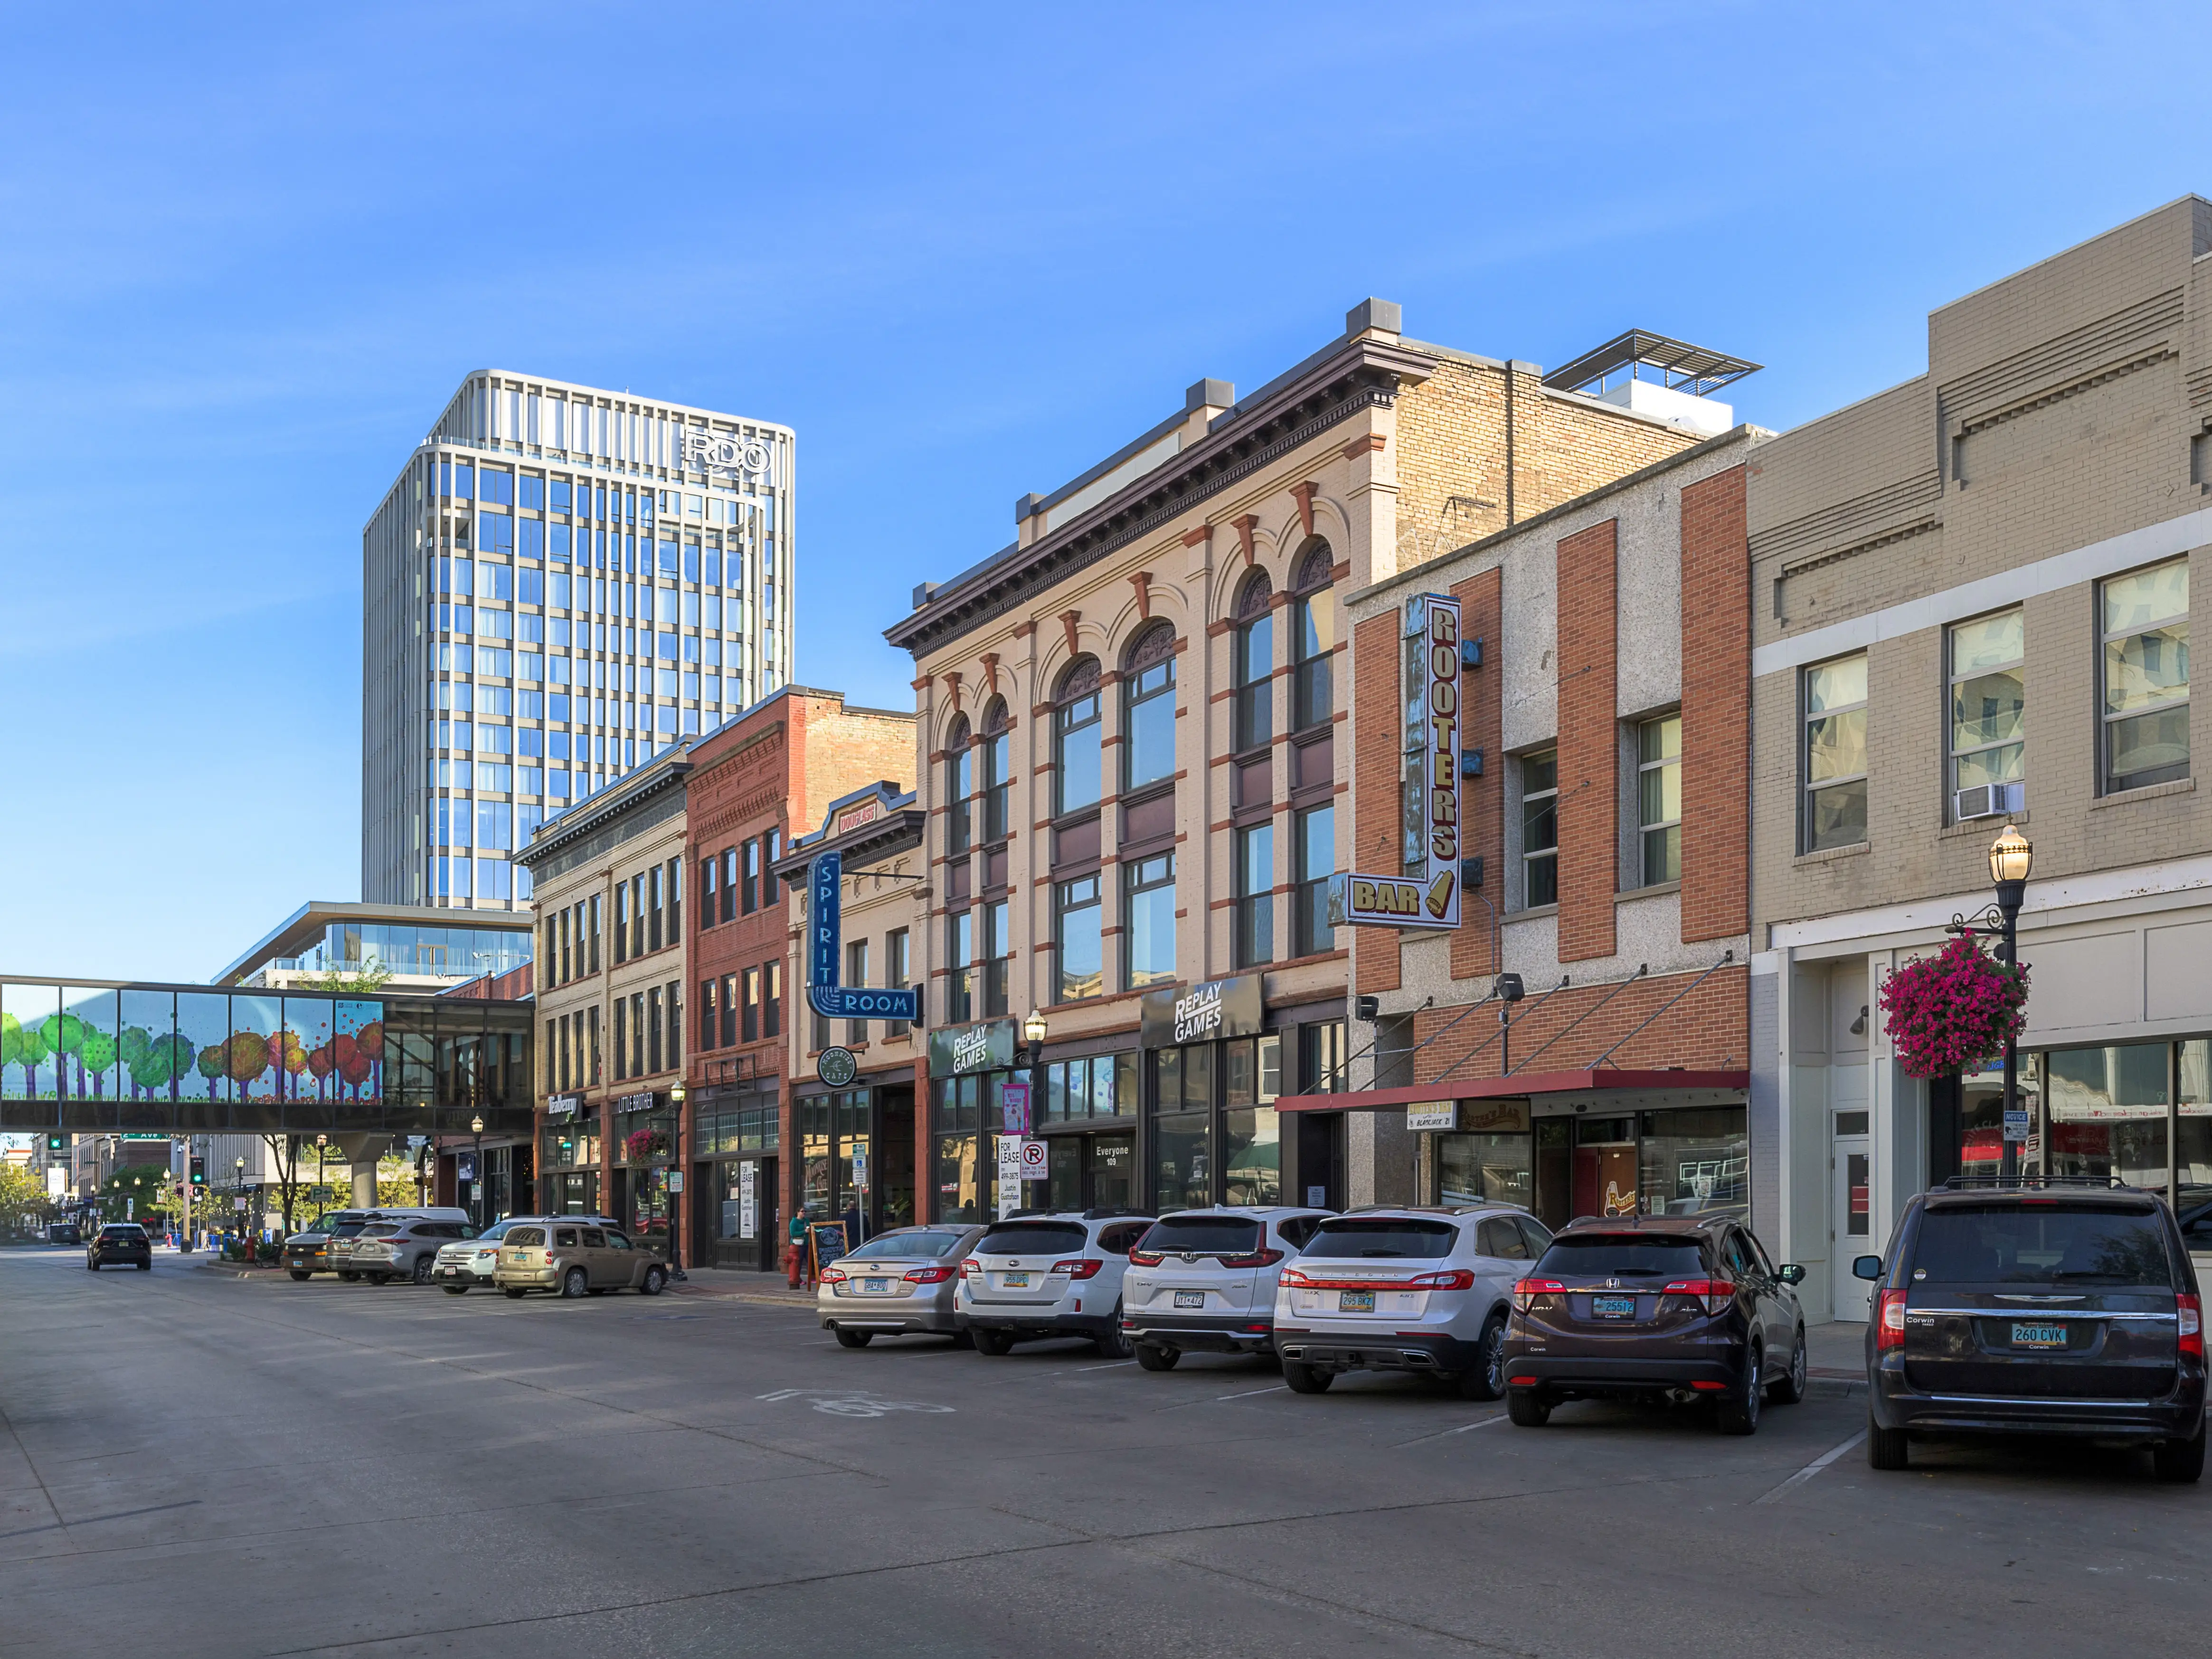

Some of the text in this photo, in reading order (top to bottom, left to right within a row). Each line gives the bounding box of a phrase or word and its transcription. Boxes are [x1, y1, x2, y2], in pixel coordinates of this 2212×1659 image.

[686, 430, 771, 473] RDO
[1432, 607, 1457, 862] ROOTERS
[841, 805, 874, 831] DOUGLASS
[1353, 881, 1420, 916] BAR
[820, 866, 832, 984] SPIRIT
[845, 995, 907, 1013] ROOM
[1175, 981, 1222, 1024] REPLAY
[1175, 1006, 1221, 1042] GAMES
[954, 1024, 987, 1058] REPLAY
[822, 1051, 852, 1065] MOONRISE
[954, 1045, 987, 1074] GAMES
[548, 1094, 577, 1115] Teaberry
[619, 1092, 653, 1113] LITTLE BROTHER
[2005, 1112, 2026, 1121] NOTICE
[1001, 1142, 1011, 1151] FOR
[1097, 1146, 1128, 1157] Everyone
[1001, 1152, 1019, 1163] LEASE
[1107, 1158, 1116, 1166] 109
[741, 1174, 753, 1182] LEASE
[313, 1188, 322, 1199] P
[1176, 1296, 1202, 1305] JYT 472
[1343, 1297, 1371, 1306] 295 BKZ
[1606, 1302, 1634, 1312] 25512
[2016, 1329, 2062, 1342] 260 CVK
